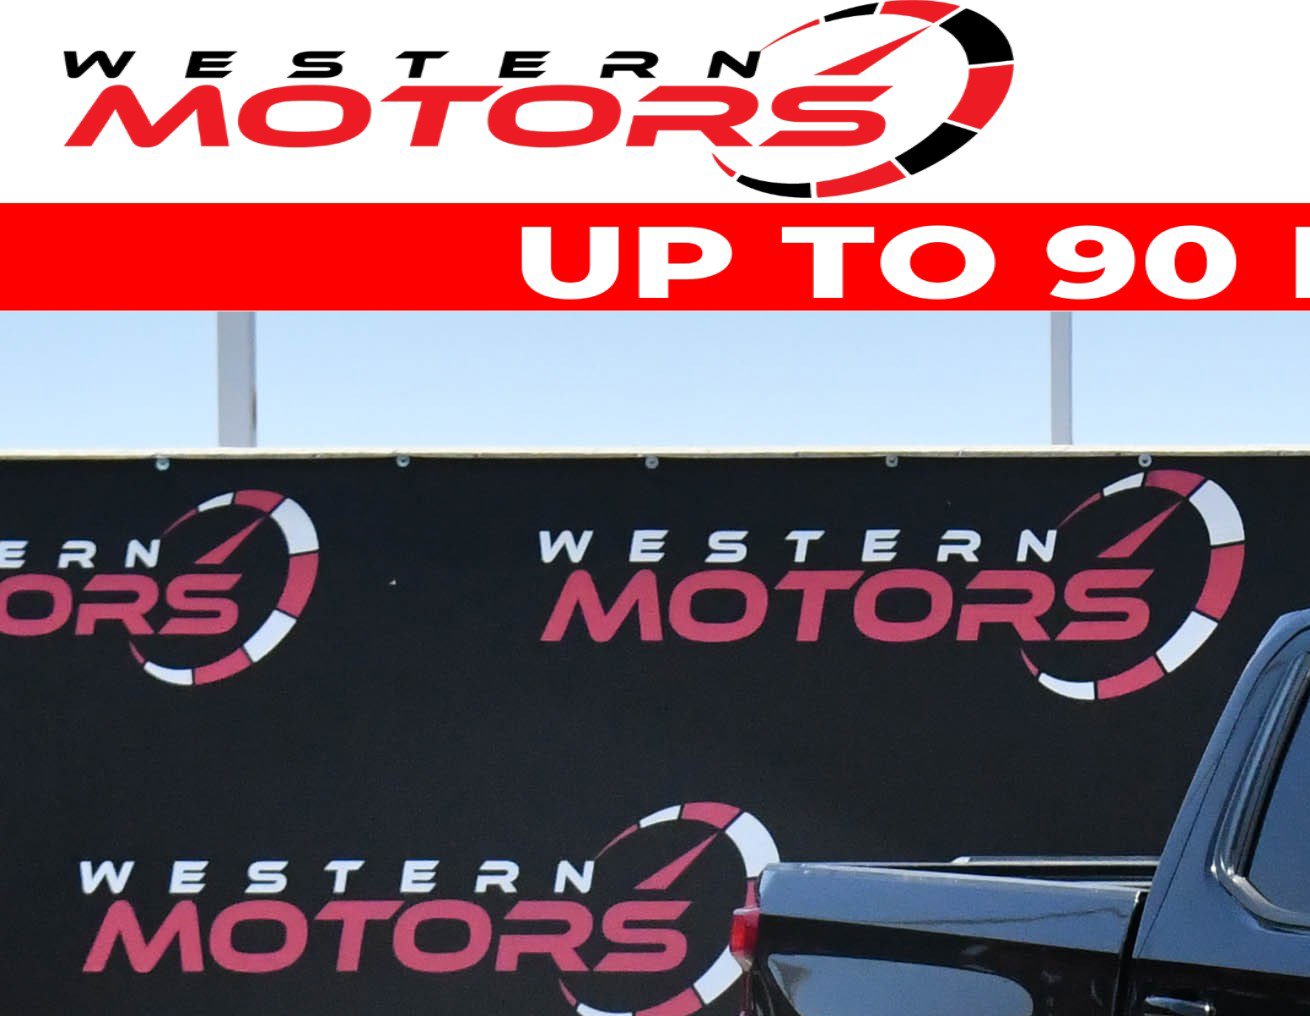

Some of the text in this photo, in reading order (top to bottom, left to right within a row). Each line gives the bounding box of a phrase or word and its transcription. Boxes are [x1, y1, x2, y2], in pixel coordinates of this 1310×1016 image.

[539, 529, 1058, 563] WESTERN
[541, 568, 1153, 643] MOTORS
[80, 860, 596, 894] WESTERN
[82, 899, 690, 973] MOTORS
